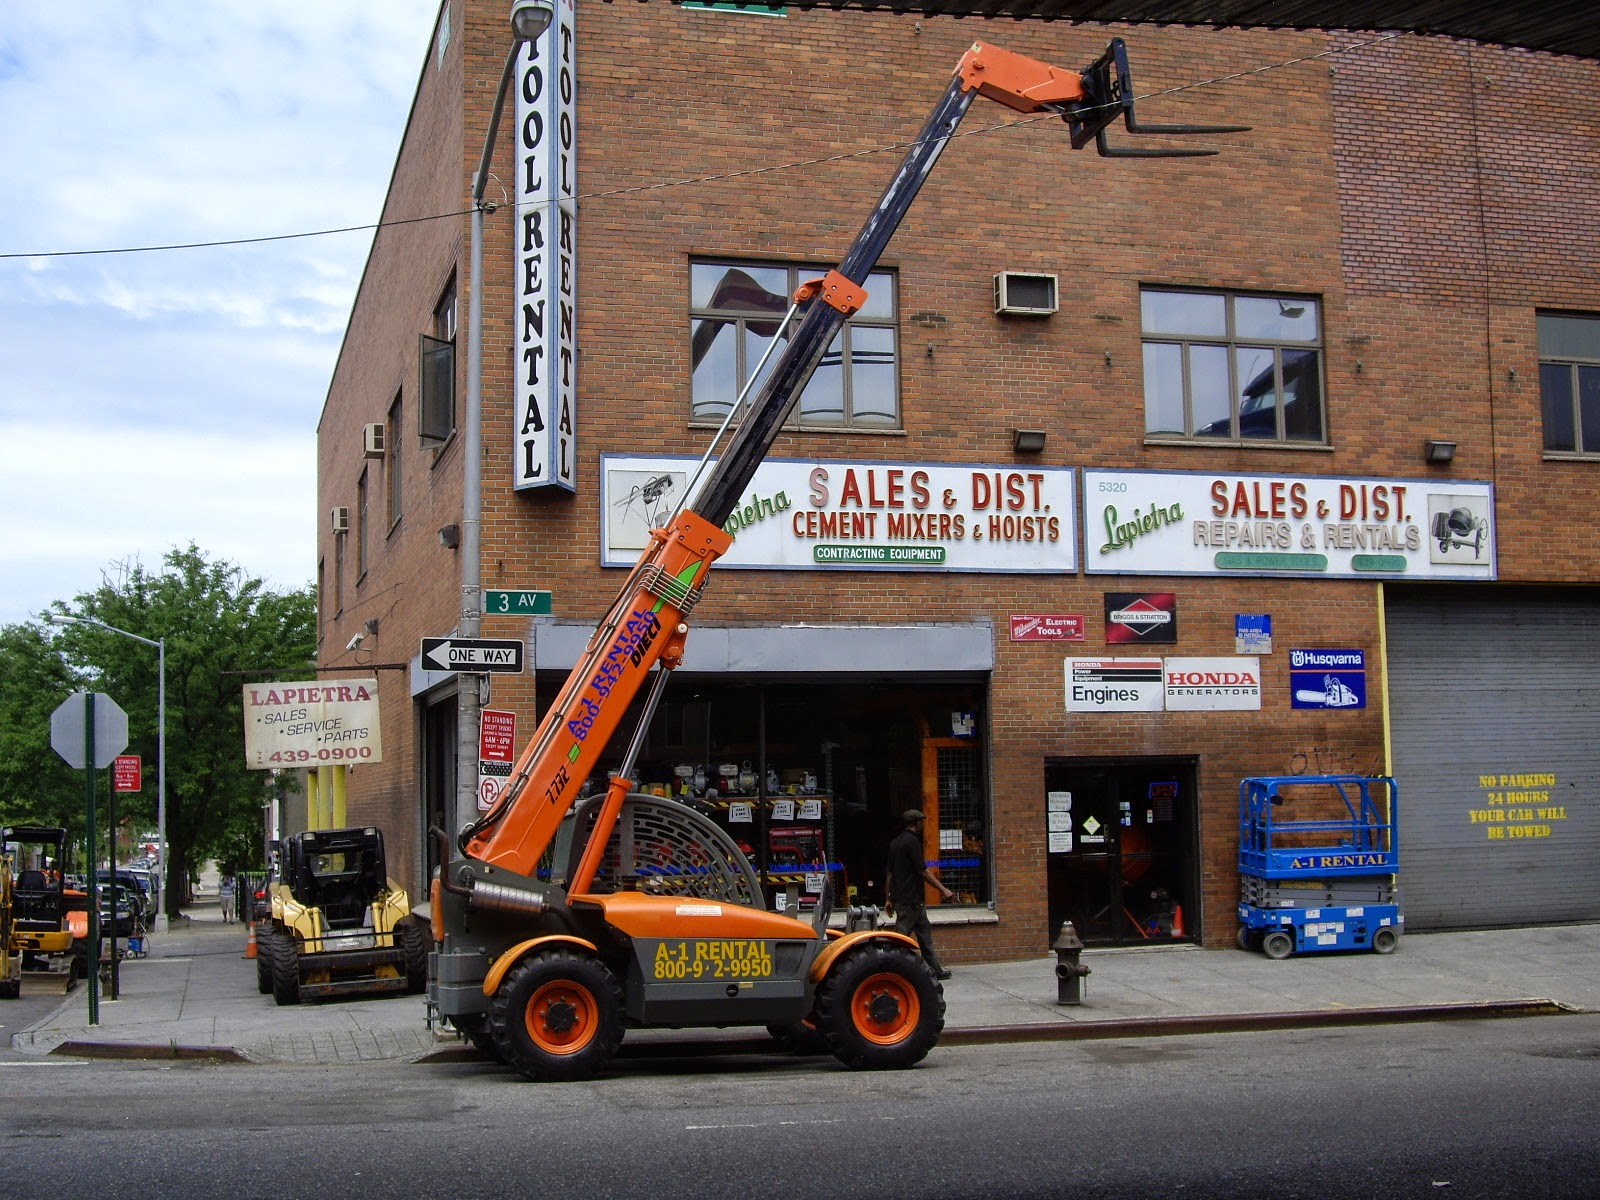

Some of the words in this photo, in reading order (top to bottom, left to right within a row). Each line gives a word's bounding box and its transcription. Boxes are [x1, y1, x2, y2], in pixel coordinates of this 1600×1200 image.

[560, 21, 572, 196] TOOL
[521, 211, 546, 479] RENTAL
[559, 209, 573, 480] RENTAL
[809, 467, 931, 508] SALES
[943, 488, 957, 509] &
[972, 472, 1051, 512] DIST.
[1099, 482, 1127, 493] 5320
[1211, 480, 1309, 519] SALES
[1316, 498, 1330, 519] &
[1339, 484, 1413, 522] DIST.
[721, 490, 792, 542] pietra
[792, 511, 878, 539] CEMENT
[887, 512, 966, 540] MIXERS
[972, 524, 983, 540] &
[988, 514, 1060, 542] HOISTS
[1099, 502, 1185, 555] Lapietra
[1193, 520, 1292, 548] REPAIRS
[1300, 523, 1316, 549] &
[1323, 524, 1421, 550] RENTALS
[817, 547, 885, 560] CONTRACTING
[890, 548, 943, 561] EQUIPMENT
[1224, 556, 1242, 565] GAS
[1256, 556, 1288, 566] POWER
[499, 594, 510, 612] 3
[518, 594, 537, 606] AV
[1037, 626, 1062, 635] TOOLS
[630, 617, 662, 669] DIECI
[448, 650, 476, 662] ONE
[484, 650, 512, 662] WAY
[1304, 653, 1362, 666] Husqvarna
[567, 697, 593, 736] A-1
[590, 608, 649, 692] RENTAL
[574, 610, 656, 741] 800-942-9950
[1167, 672, 1258, 685] HONDA
[250, 686, 372, 706] LAPIETRA
[1072, 686, 1139, 705] Engines
[264, 708, 307, 724] SALES
[286, 718, 342, 736] SERVICE
[324, 728, 368, 743] PARTS
[269, 746, 372, 763] 439-0900
[545, 765, 570, 805] 7.732
[1479, 775, 1496, 788] NO
[1500, 774, 1556, 788] PARKING
[1488, 792, 1504, 805] 24
[1506, 790, 1550, 804] HOURS
[1469, 809, 1505, 824] YOUR
[1508, 808, 1534, 820] CAR
[1538, 806, 1568, 819] WILL
[1488, 826, 1504, 838] BE
[1507, 824, 1552, 838] TOWED
[1290, 858, 1314, 869] A-1
[1320, 854, 1388, 868] RENTAL
[655, 942, 689, 960] A-1
[695, 941, 771, 960] RENTAL
[654, 958, 772, 979] 800-92-9950
